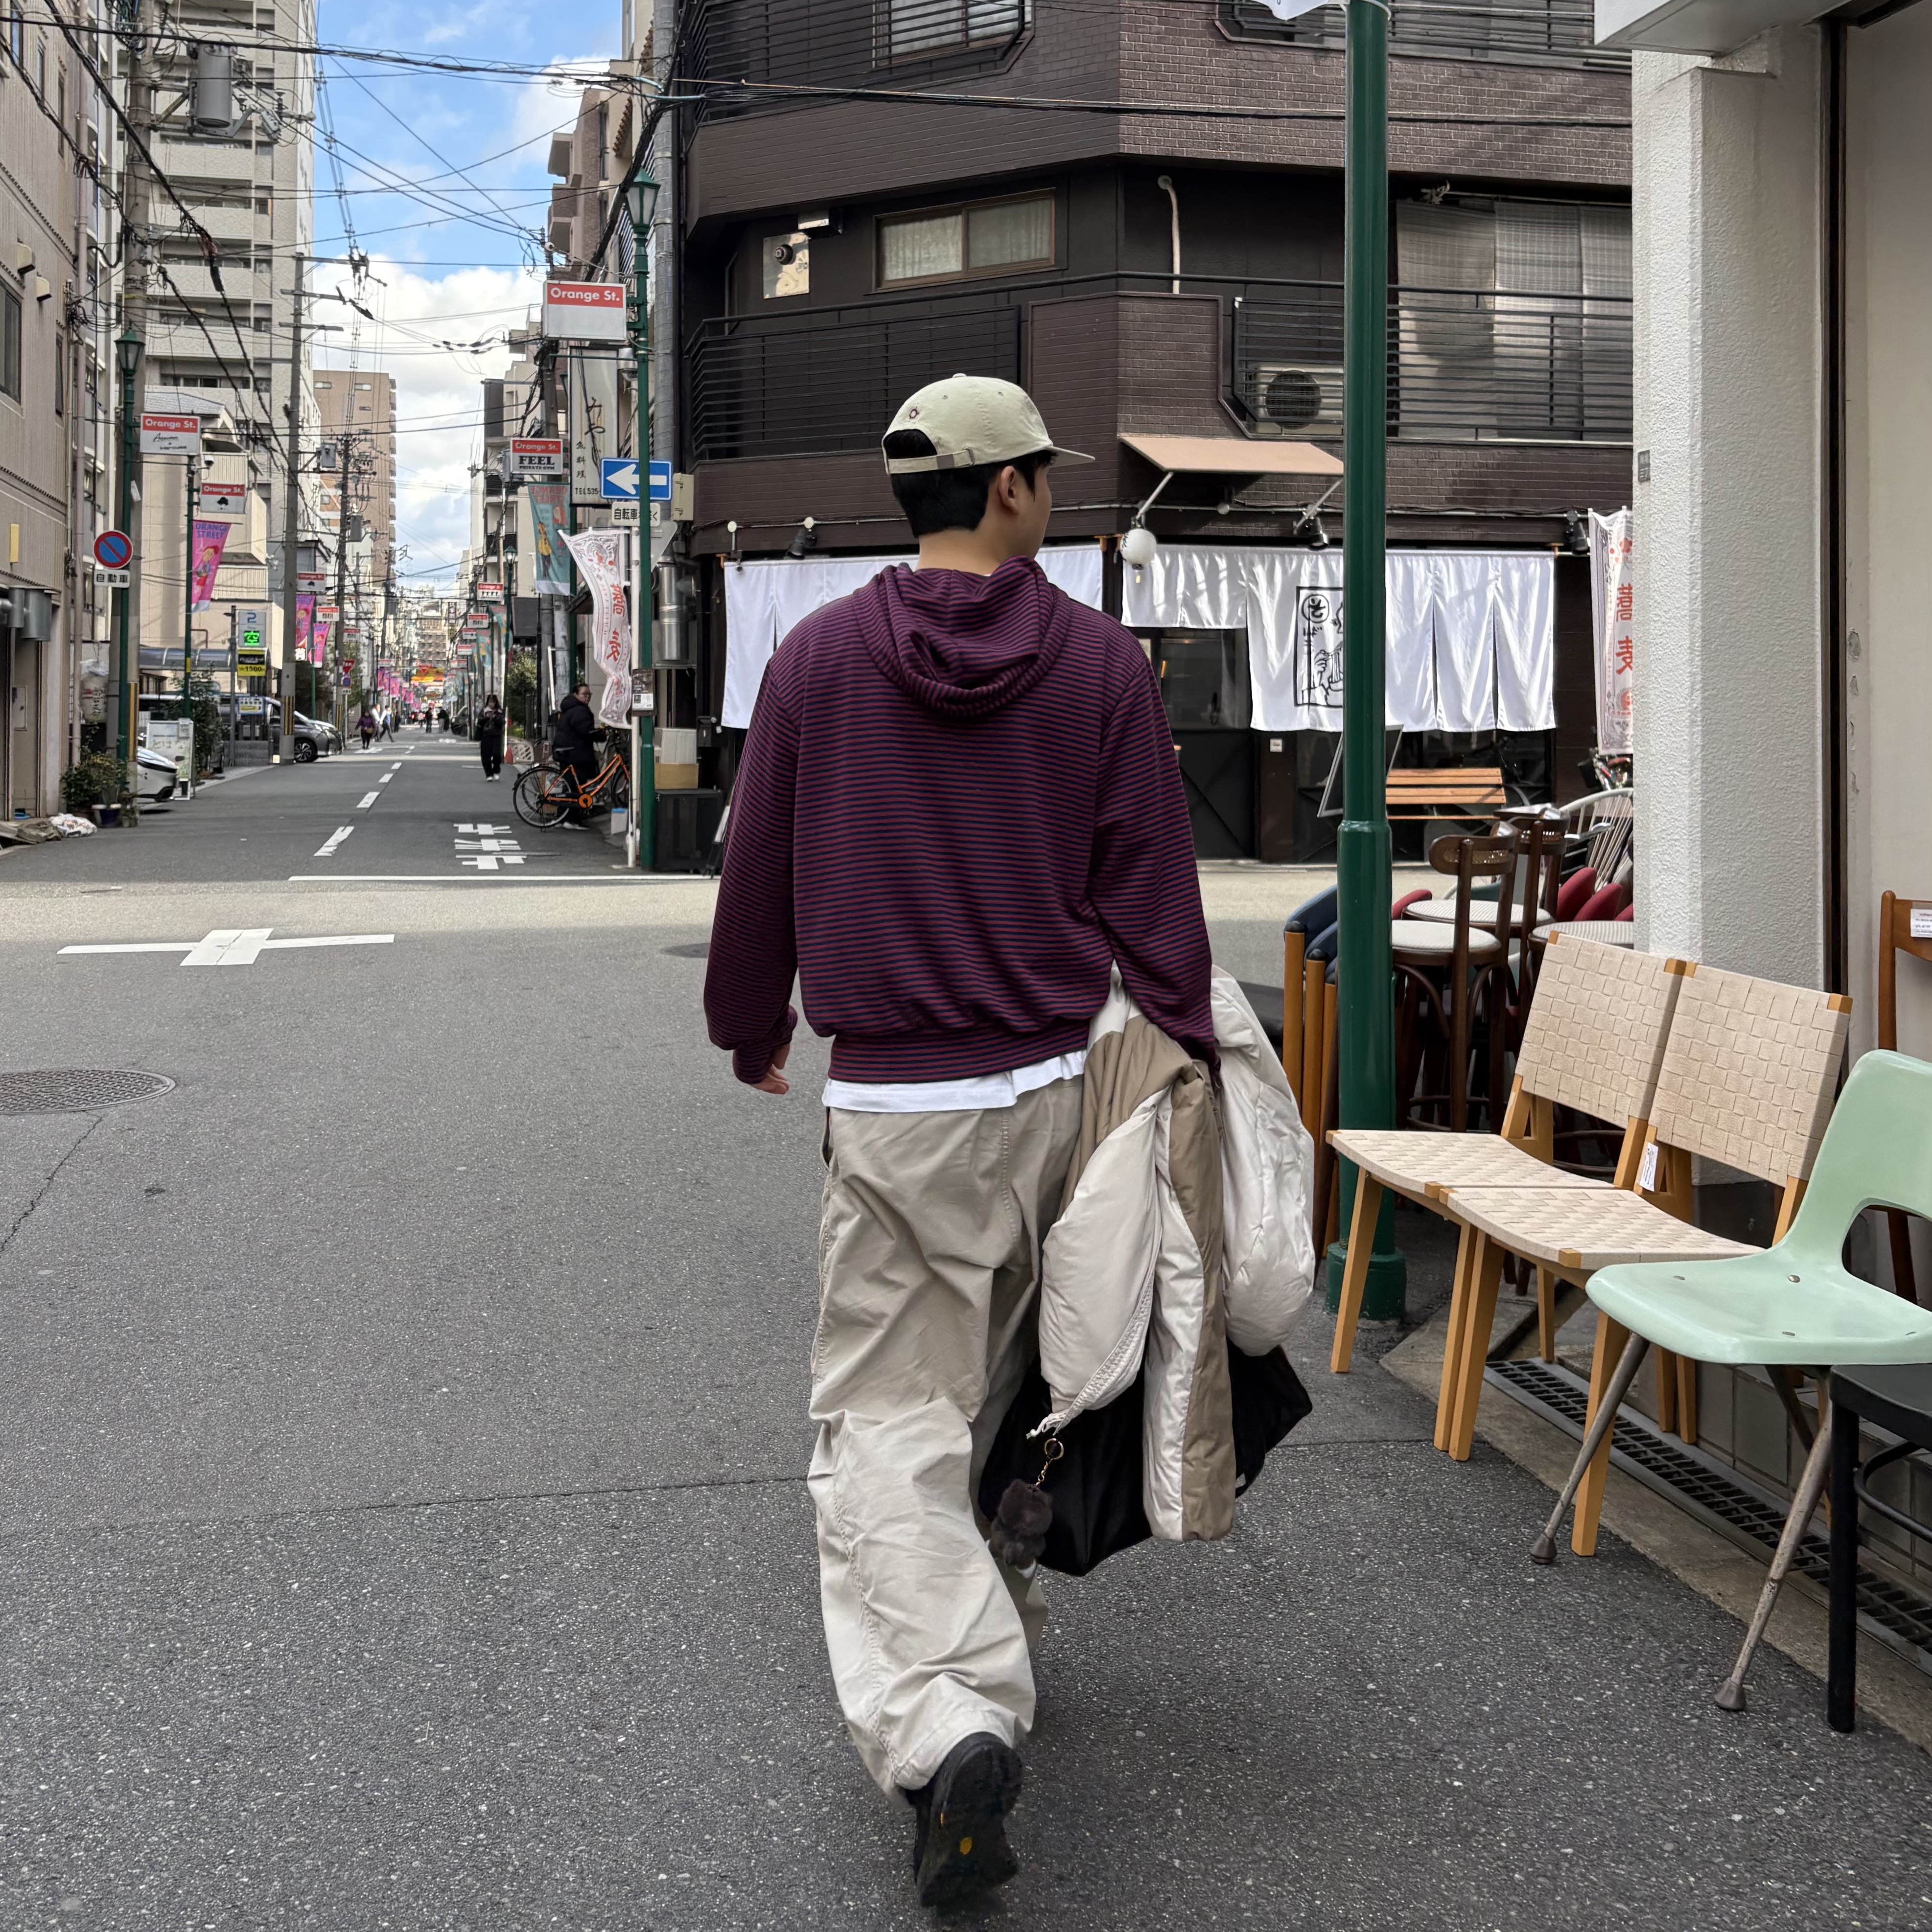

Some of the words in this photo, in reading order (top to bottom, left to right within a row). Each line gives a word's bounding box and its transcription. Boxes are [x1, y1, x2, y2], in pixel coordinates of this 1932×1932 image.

[550, 287, 600, 302] Orange
[604, 290, 620, 301] St.
[145, 419, 181, 429] Orange
[515, 442, 546, 451] Orange
[519, 456, 555, 465] FEEL
[576, 441, 586, 478] 魚料理
[204, 485, 232, 494] Orange
[614, 507, 657, 521] 自転車く
[96, 574, 128, 583] 自動車
[244, 630, 259, 645] 空
